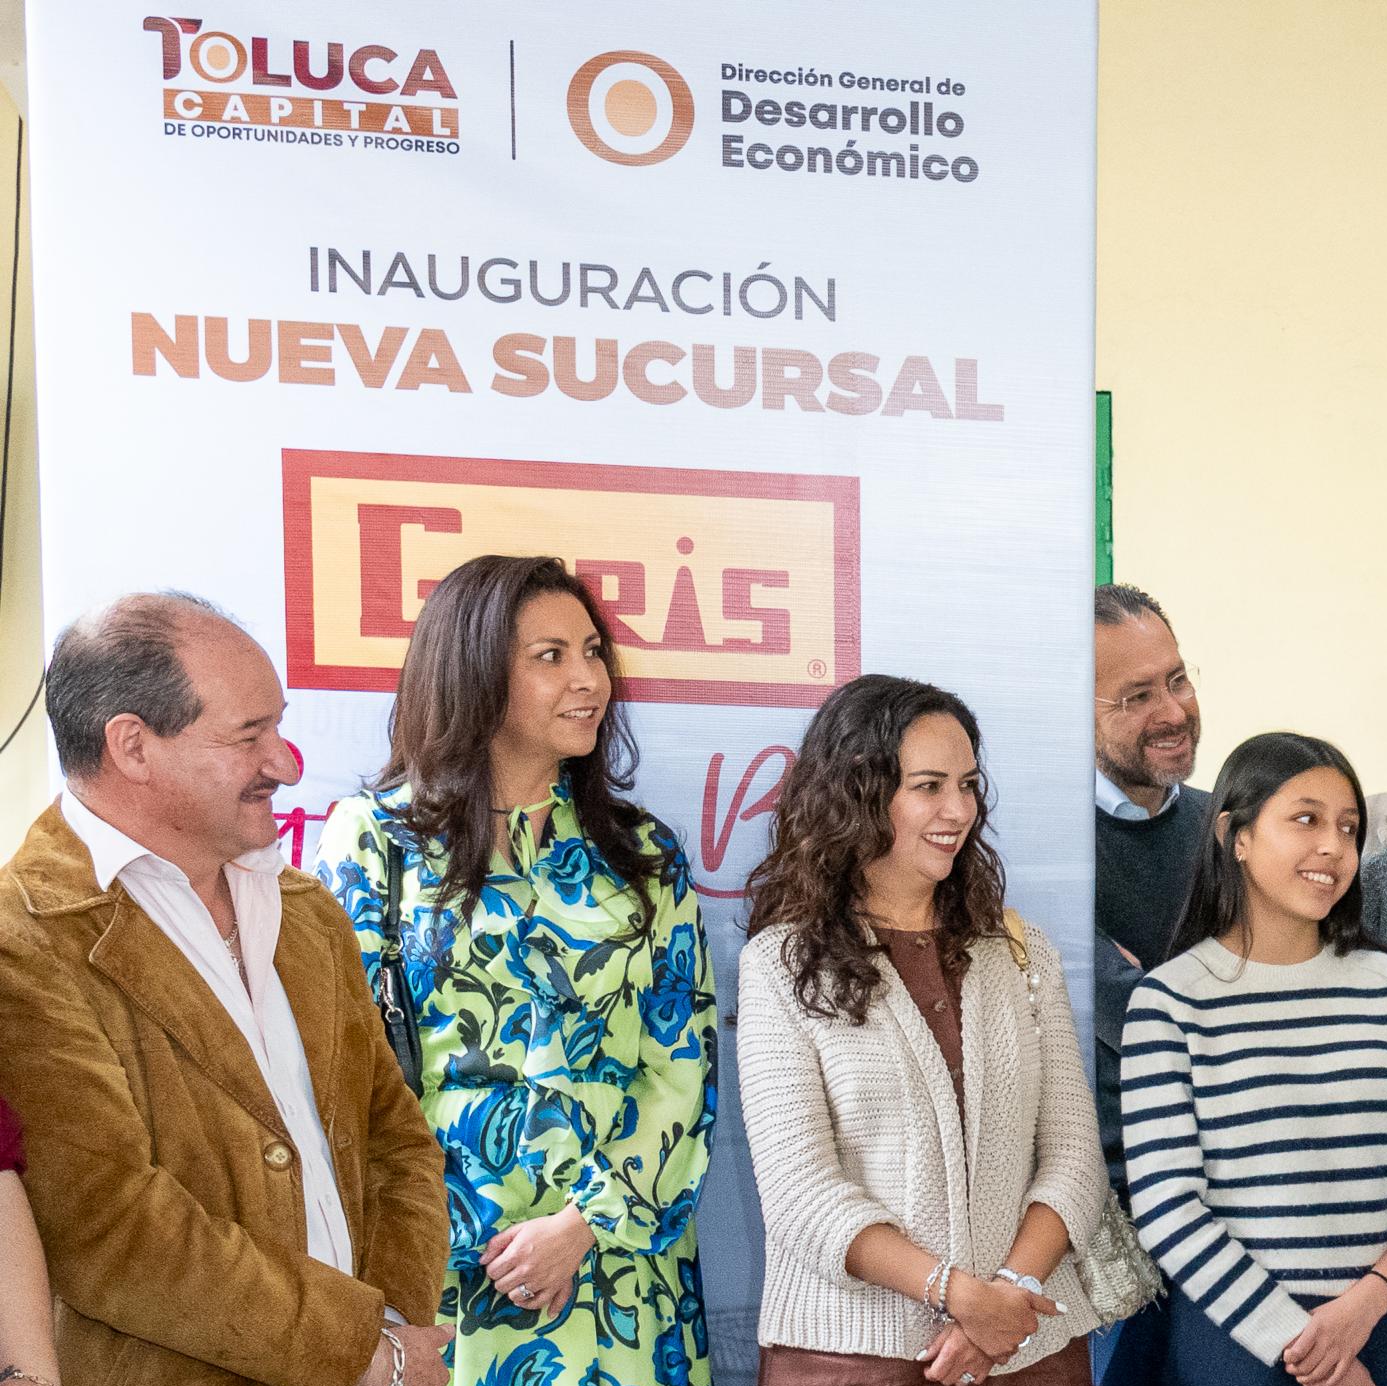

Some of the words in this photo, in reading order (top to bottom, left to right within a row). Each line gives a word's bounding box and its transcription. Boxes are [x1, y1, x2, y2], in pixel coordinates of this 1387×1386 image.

[143, 16, 458, 99] TOLUCA
[721, 63, 832, 88] Dirección
[838, 72, 931, 94] General
[936, 78, 966, 96] de
[173, 91, 451, 136] CAPITAL
[721, 89, 965, 138] Desarrollo
[163, 122, 187, 137] DE
[191, 124, 343, 147] OPORTUNIDADES
[348, 135, 359, 148] Y
[363, 136, 460, 155] PROGRESO
[722, 134, 979, 183] Económico
[309, 246, 837, 322] INAUGURACIÓN
[131, 311, 473, 394] NUEVA
[490, 332, 1005, 422] SUCURSAL
